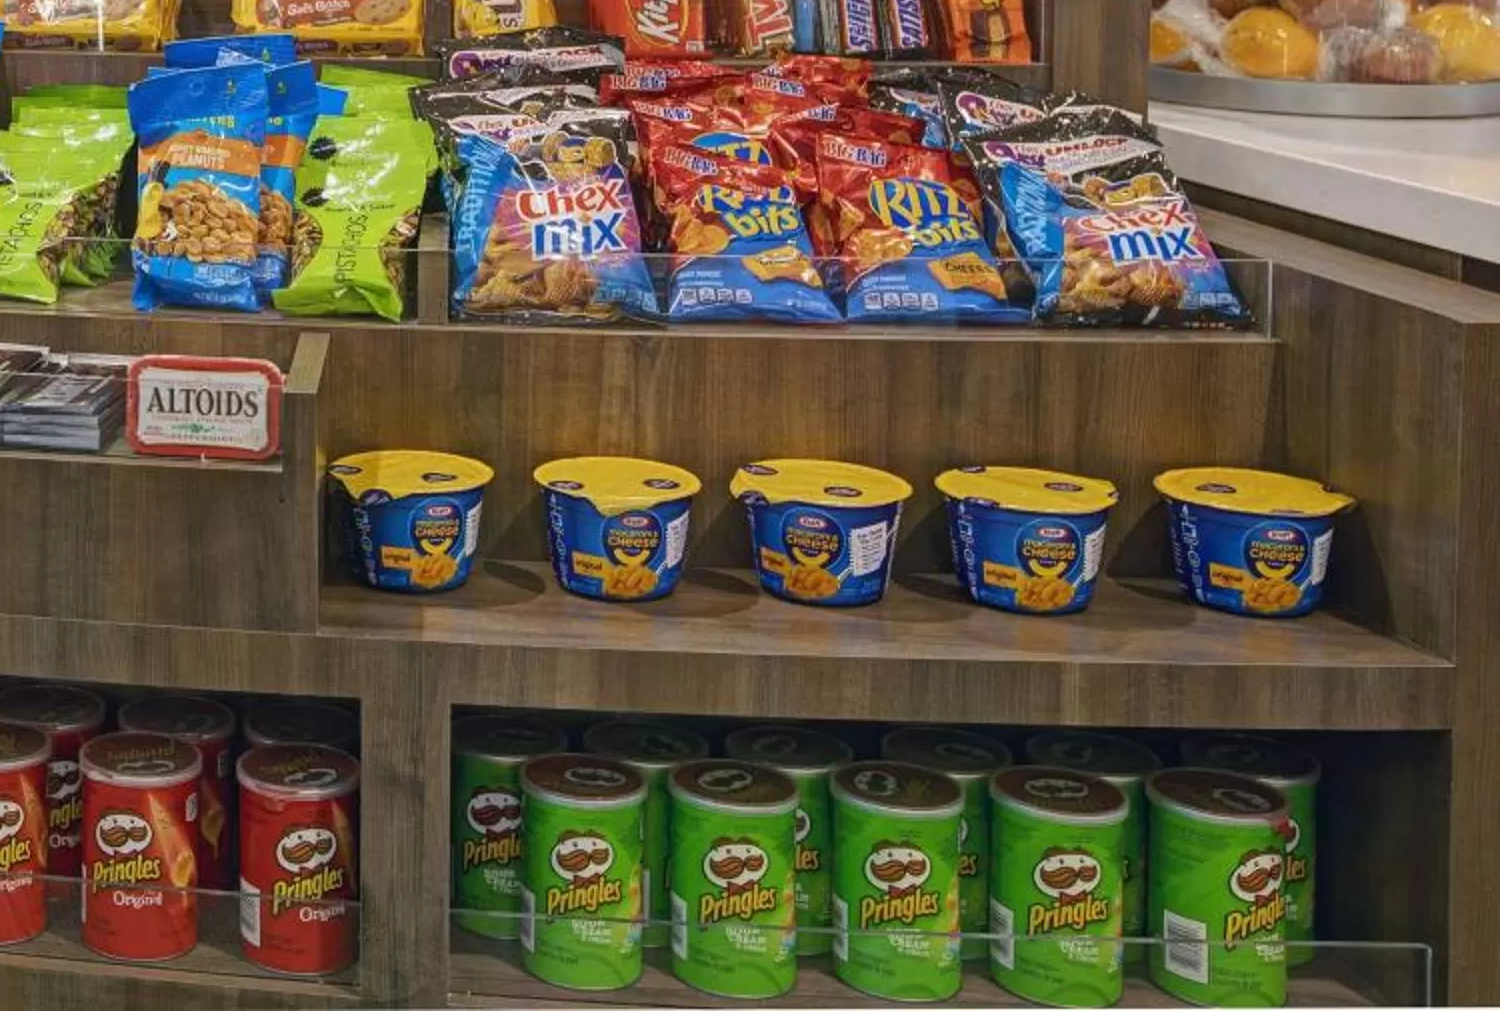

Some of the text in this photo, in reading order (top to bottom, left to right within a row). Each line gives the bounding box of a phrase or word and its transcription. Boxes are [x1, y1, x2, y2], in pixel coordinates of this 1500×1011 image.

[518, 179, 624, 220] Chex
[870, 178, 975, 230] RITZ
[1079, 200, 1190, 235] Chex
[723, 205, 800, 238] bits
[147, 385, 259, 418] ALTOIDS
[463, 832, 522, 872] Pringl
[93, 853, 161, 893] Pringles
[273, 869, 344, 916] Pringles
[112, 891, 164, 909] Original
[547, 877, 622, 921] Pringles
[699, 884, 777, 926] Pringles
[860, 887, 939, 930] Pringles
[1028, 891, 1109, 938] Pringles
[1223, 895, 1286, 951] Pringle
